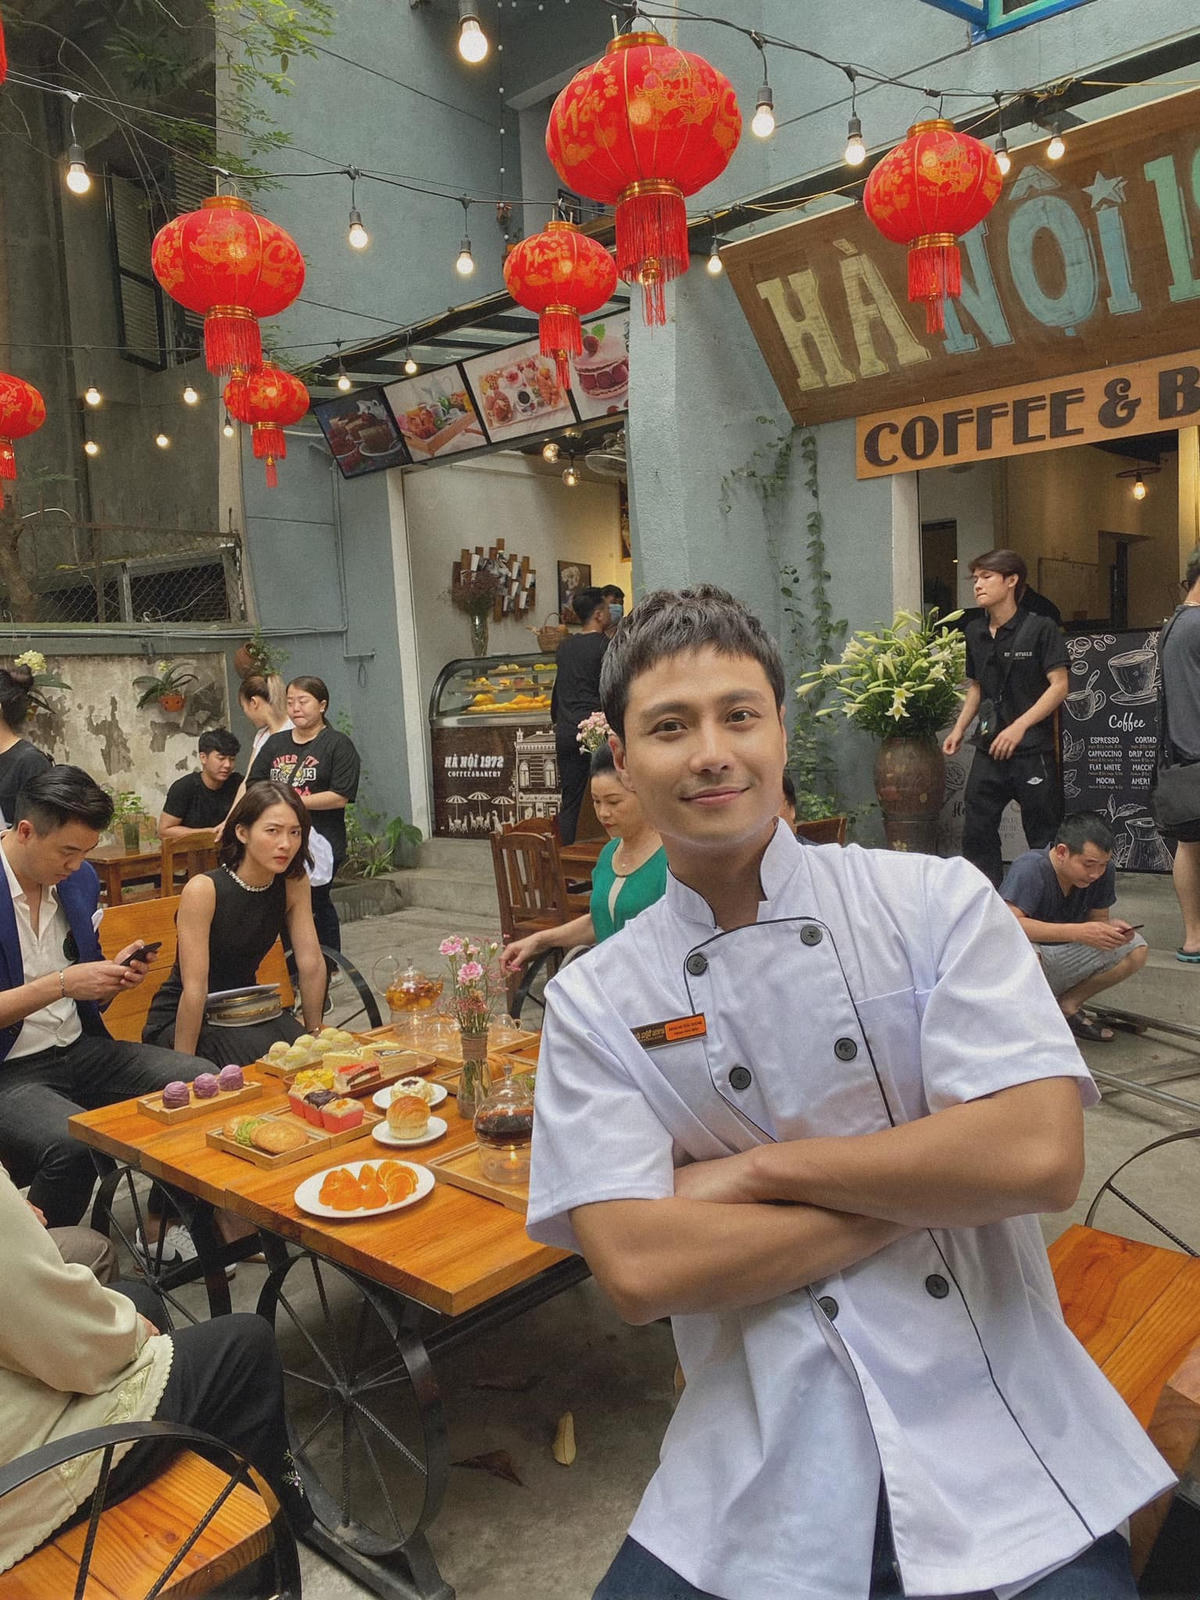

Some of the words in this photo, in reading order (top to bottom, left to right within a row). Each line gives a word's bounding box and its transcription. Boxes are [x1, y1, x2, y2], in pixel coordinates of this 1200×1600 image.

[756, 238, 932, 392] HÀ
[863, 387, 1086, 467] COFFEE
[1097, 377, 1142, 429] &
[1109, 712, 1145, 731] Coffee
[480, 755, 505, 769] 1972
